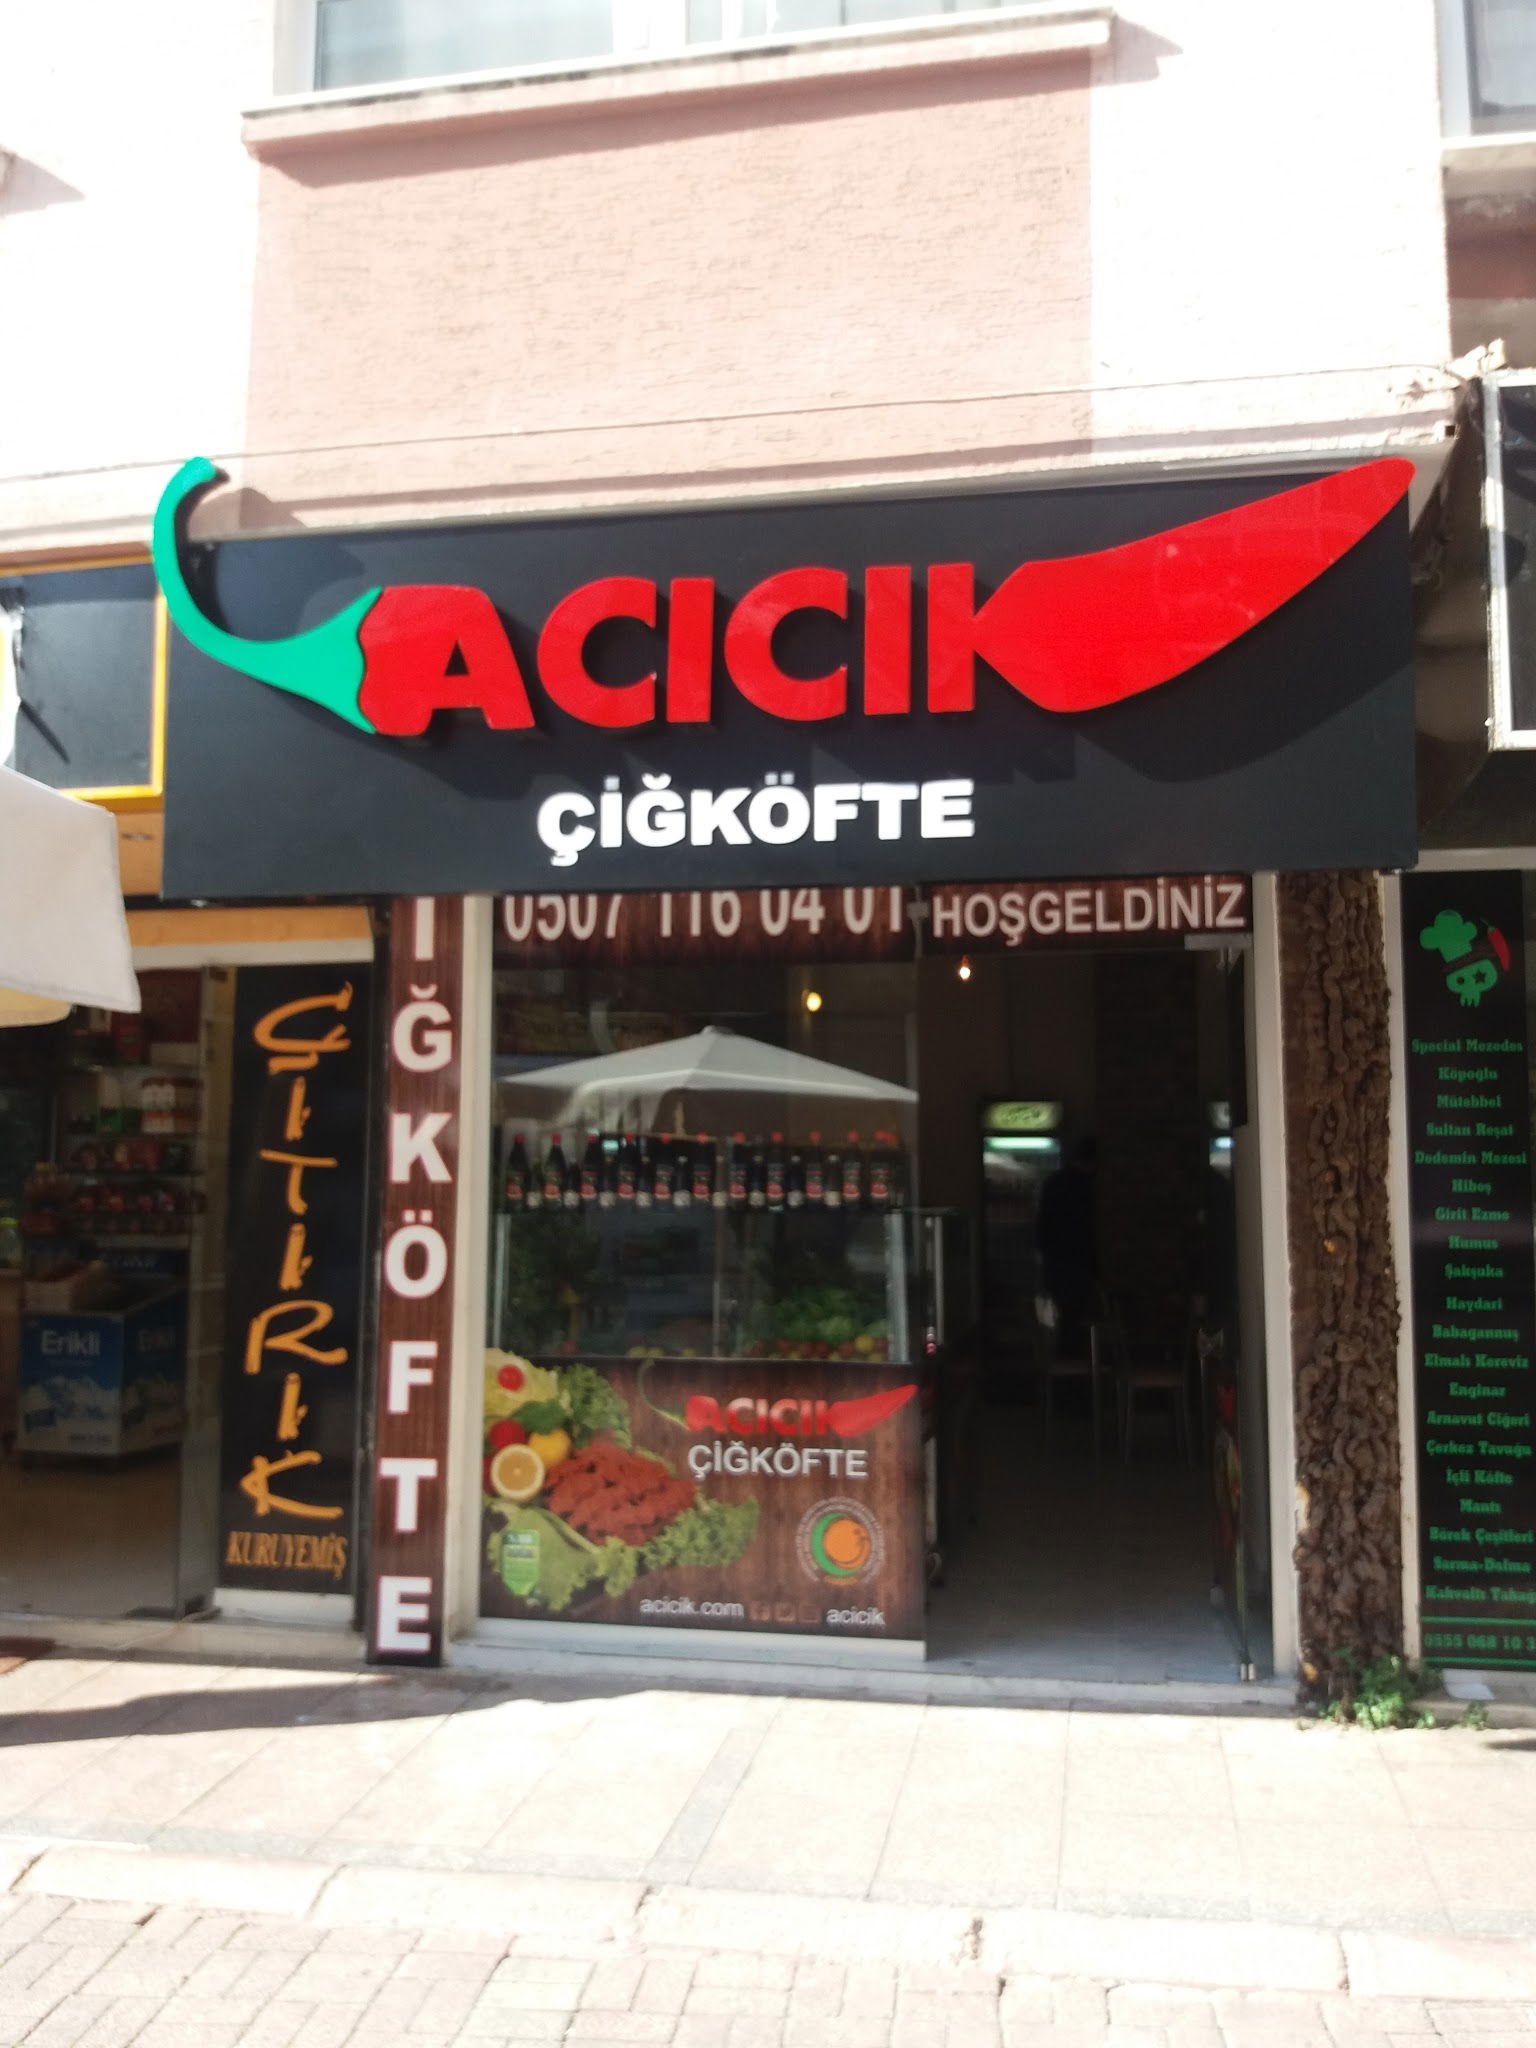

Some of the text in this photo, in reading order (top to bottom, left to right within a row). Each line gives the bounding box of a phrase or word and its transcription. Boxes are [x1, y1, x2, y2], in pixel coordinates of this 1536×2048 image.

[537, 772, 976, 868] ÇİĞKÖFTE
[503, 893, 623, 941] 0507
[760, 888, 825, 937] 04
[933, 875, 1246, 946] HOŞGELDİNİZ
[685, 1389, 885, 1437] ACICIK
[687, 1440, 869, 1479] ÇİĞKÖFTE
[225, 1530, 349, 1581] KURUYEMİŞ
